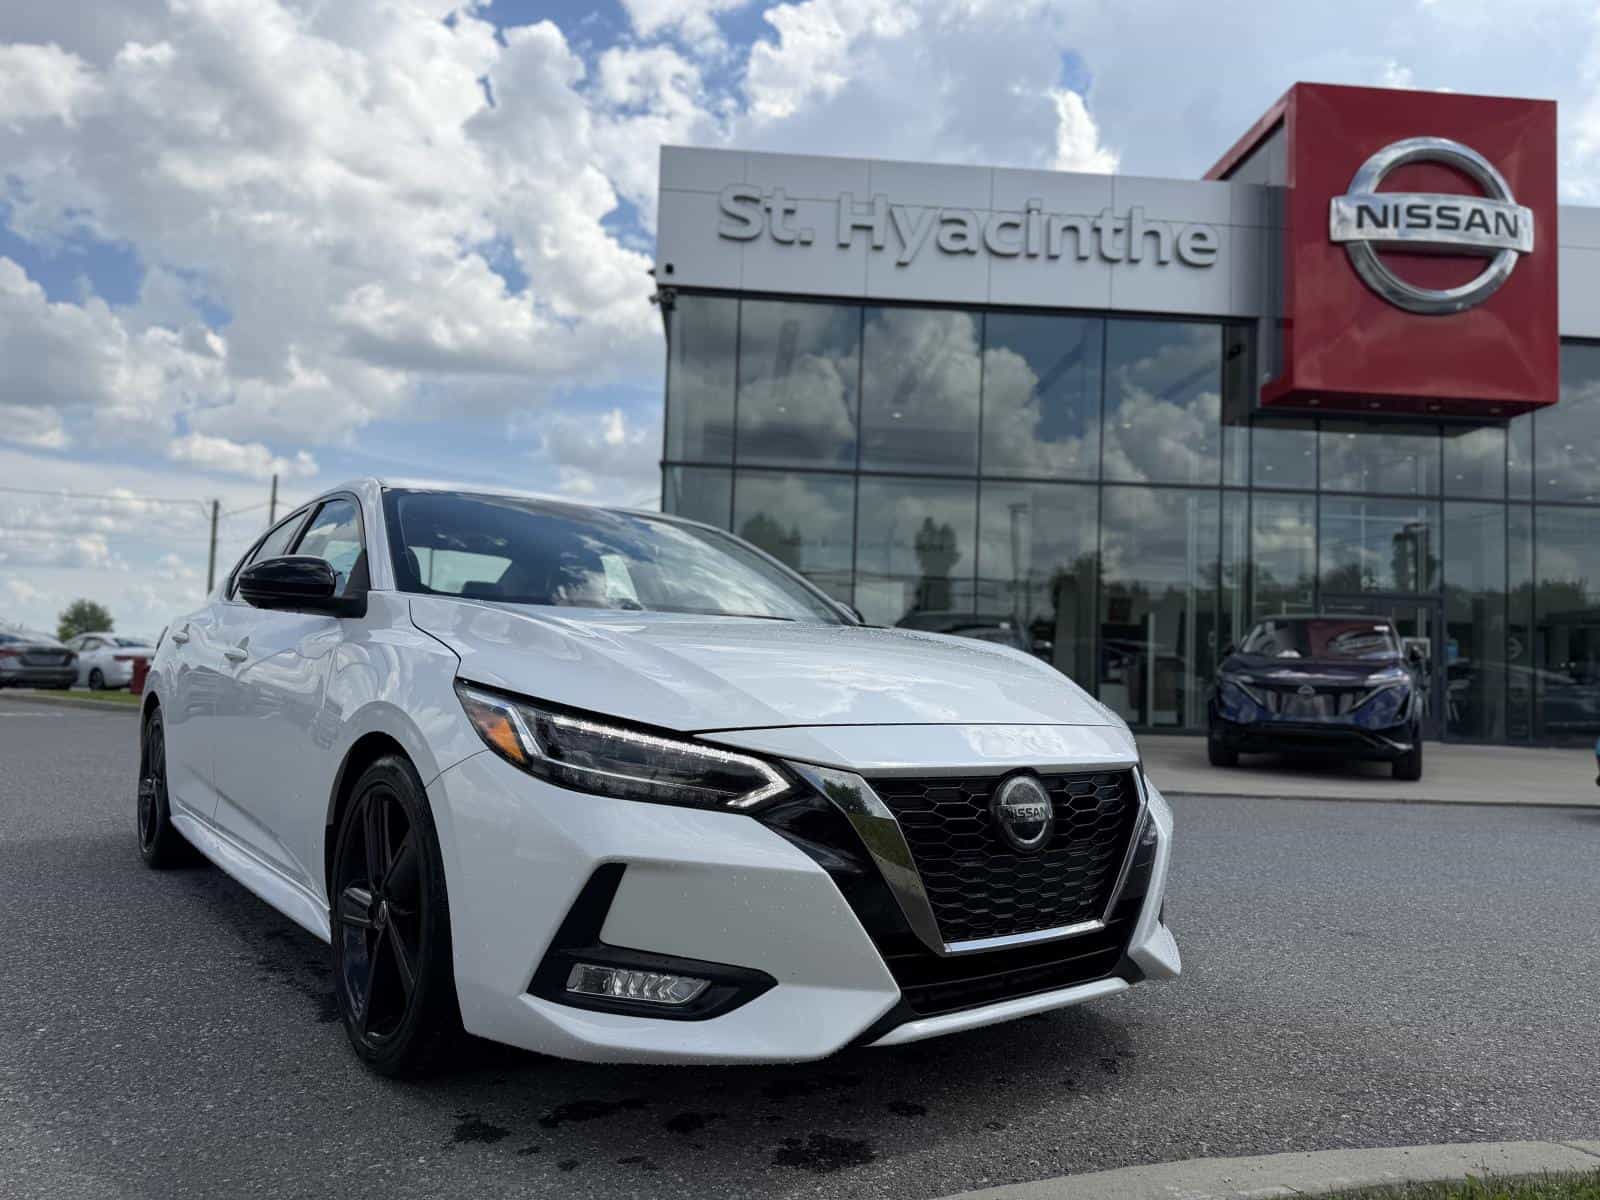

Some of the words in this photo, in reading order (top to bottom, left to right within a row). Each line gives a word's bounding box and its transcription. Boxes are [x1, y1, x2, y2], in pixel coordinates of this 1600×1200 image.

[718, 184, 813, 246] St.
[836, 191, 1219, 268] Hyacinthe
[1356, 204, 1518, 238] NISSAN
